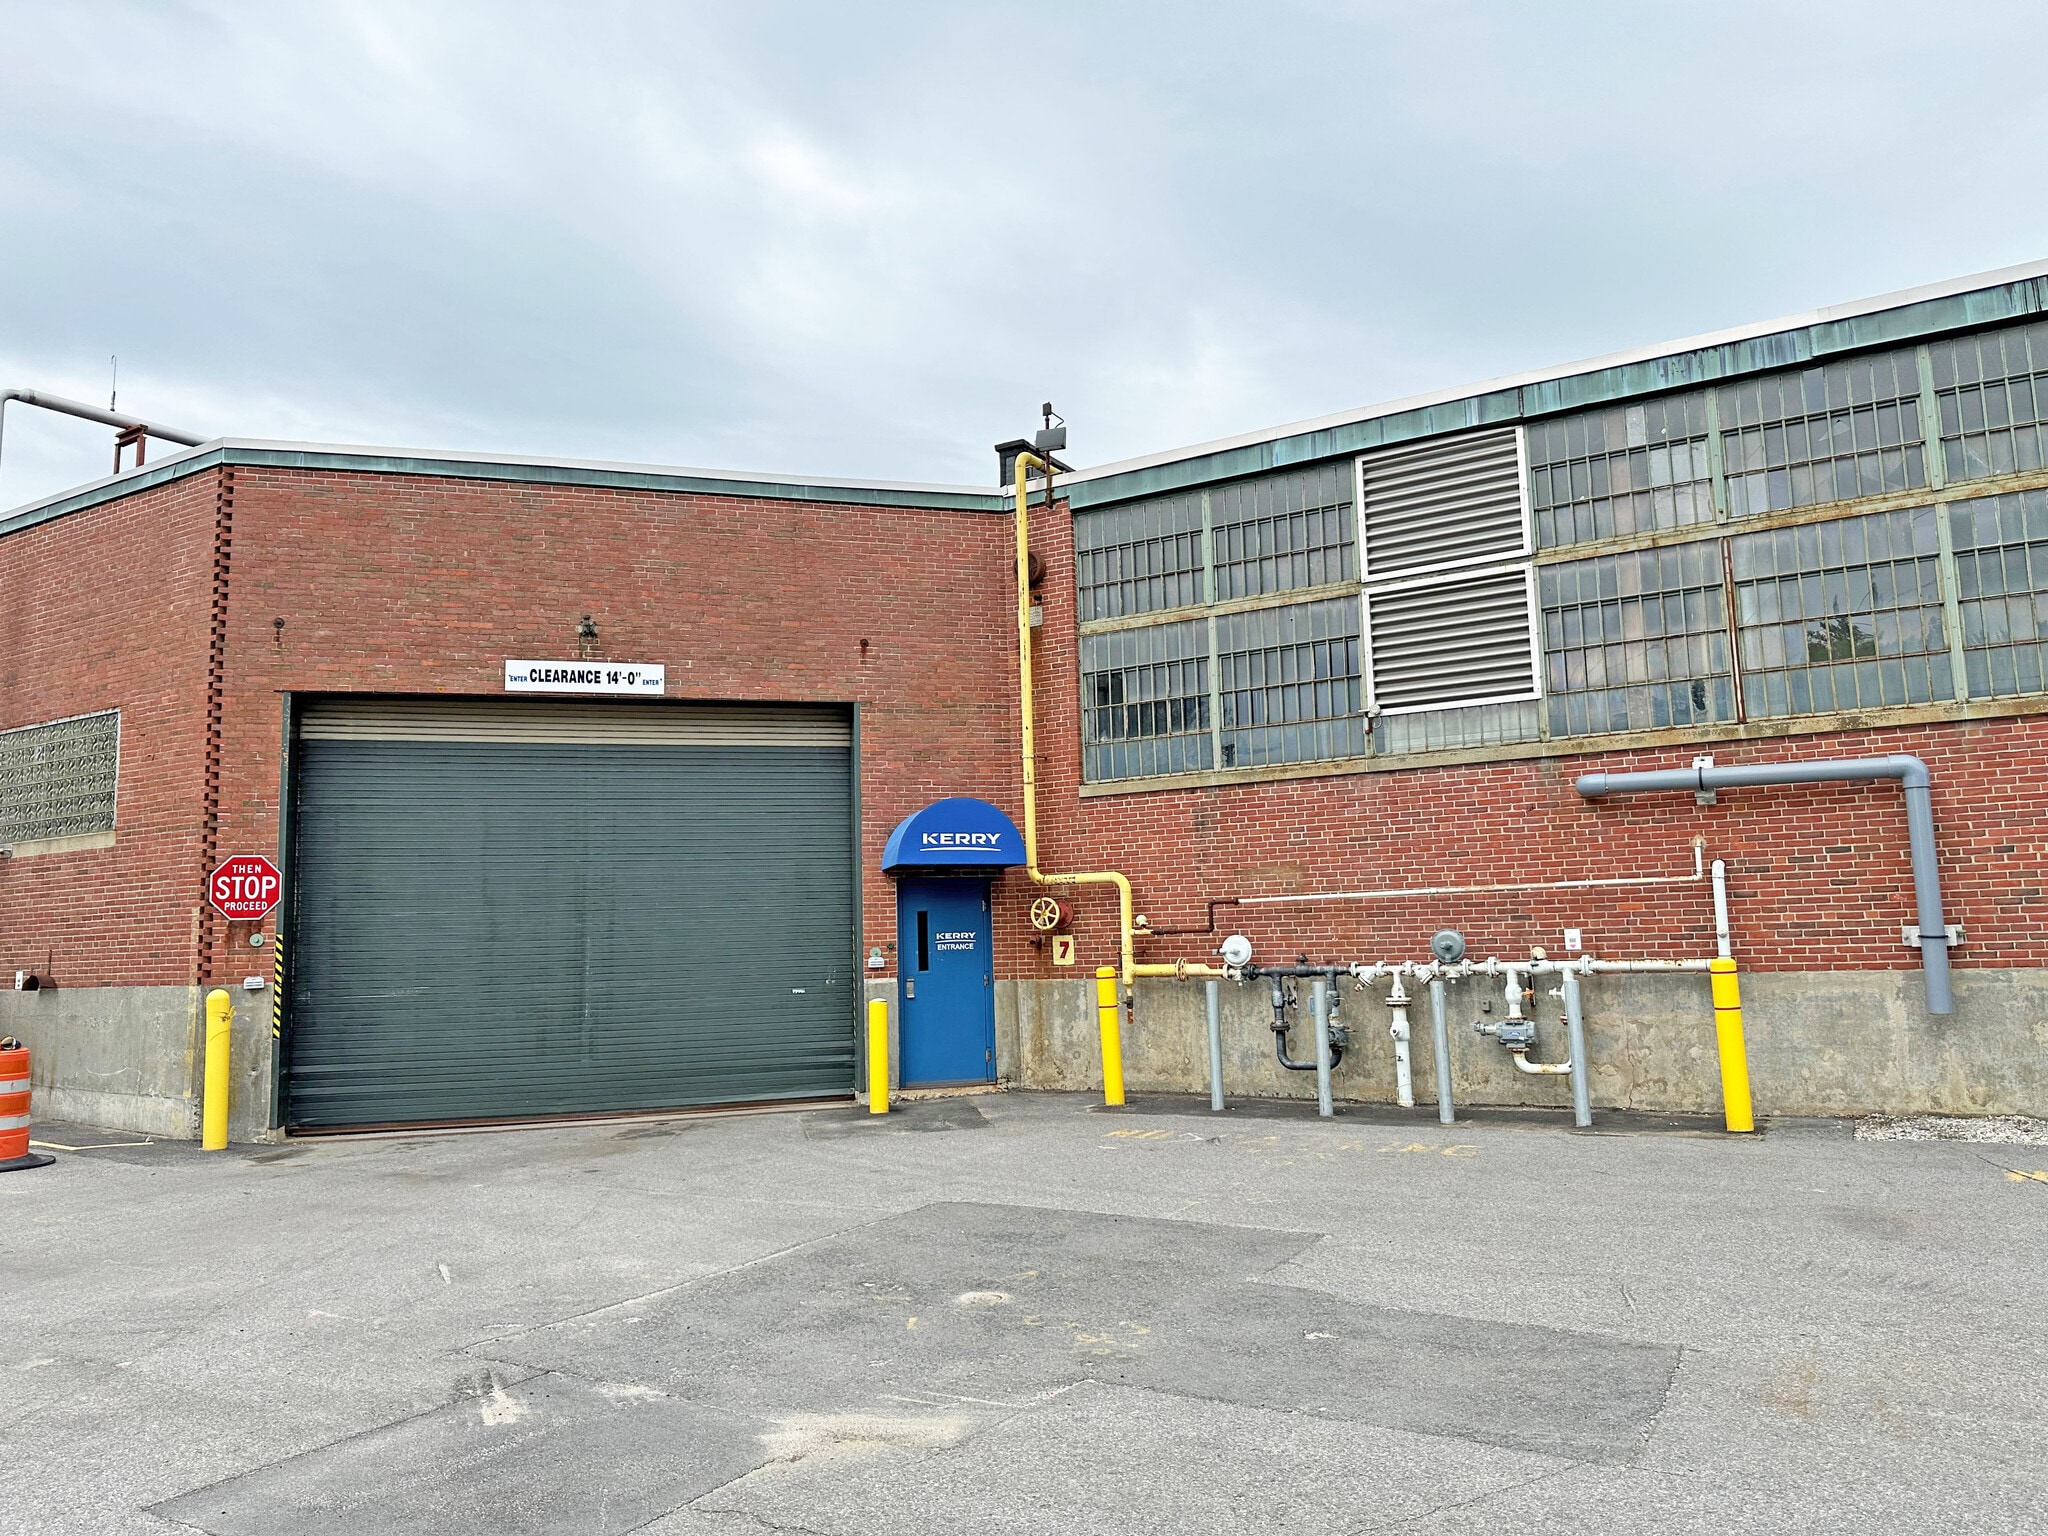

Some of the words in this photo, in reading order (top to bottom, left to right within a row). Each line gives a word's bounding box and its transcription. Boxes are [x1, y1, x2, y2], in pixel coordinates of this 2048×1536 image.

[528, 668, 602, 684] CLEARANCE
[606, 670, 641, 685] 14'-0"
[922, 833, 1002, 845] KERRY
[232, 864, 262, 874] THEN
[215, 875, 277, 900] STOP
[224, 901, 268, 911] PROCEED
[936, 932, 976, 940] KERRY
[937, 943, 974, 951] ENTRANCE
[1059, 941, 1070, 959] 7
